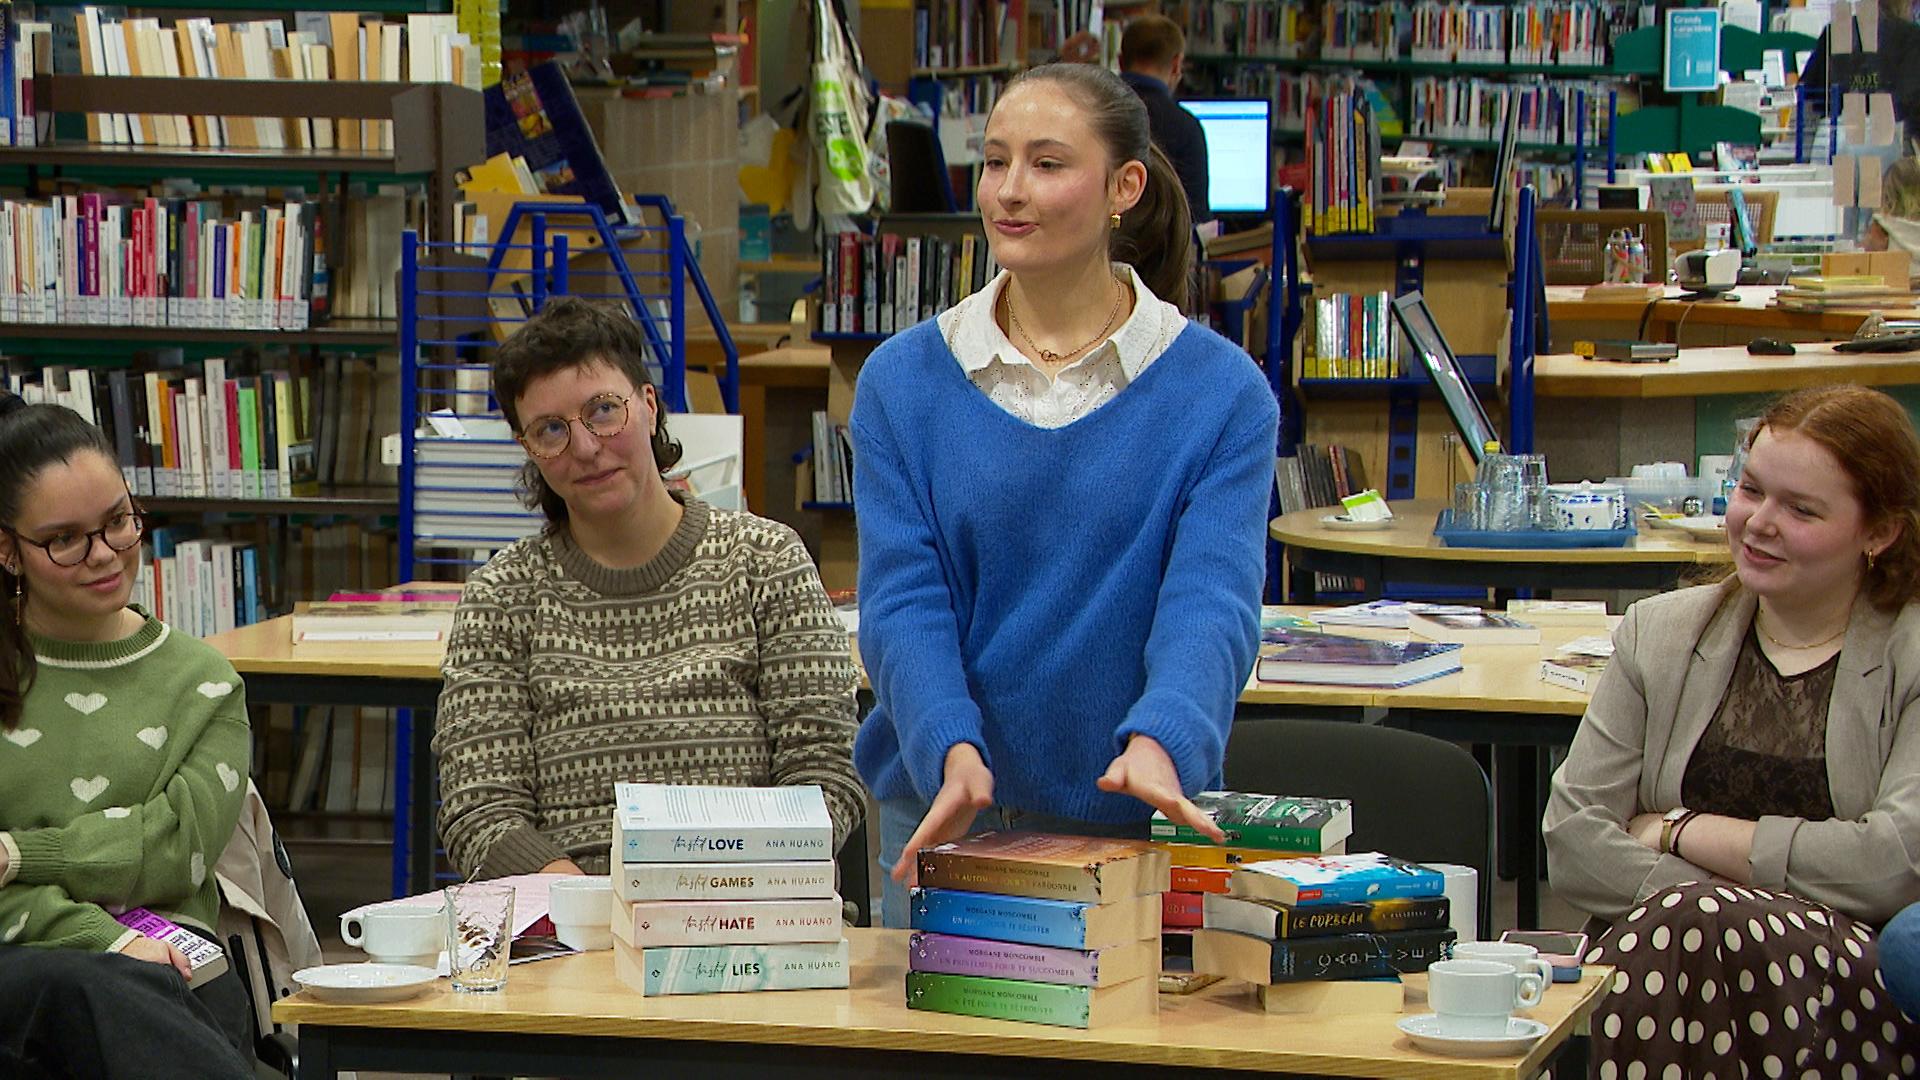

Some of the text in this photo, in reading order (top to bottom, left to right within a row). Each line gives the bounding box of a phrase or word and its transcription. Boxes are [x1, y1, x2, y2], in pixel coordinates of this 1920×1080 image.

[708, 838, 744, 851] LOVE
[766, 839, 786, 848] ANA
[789, 838, 825, 848] HUANG
[710, 877, 754, 889] GAMES
[767, 877, 788, 886] ANA
[791, 877, 825, 886] HUANG
[719, 917, 755, 930] HATE
[775, 917, 797, 927] ANA
[799, 917, 833, 927] HUANG
[732, 963, 760, 977] LIES
[784, 961, 805, 971] ANA
[807, 961, 841, 971] HUANG
